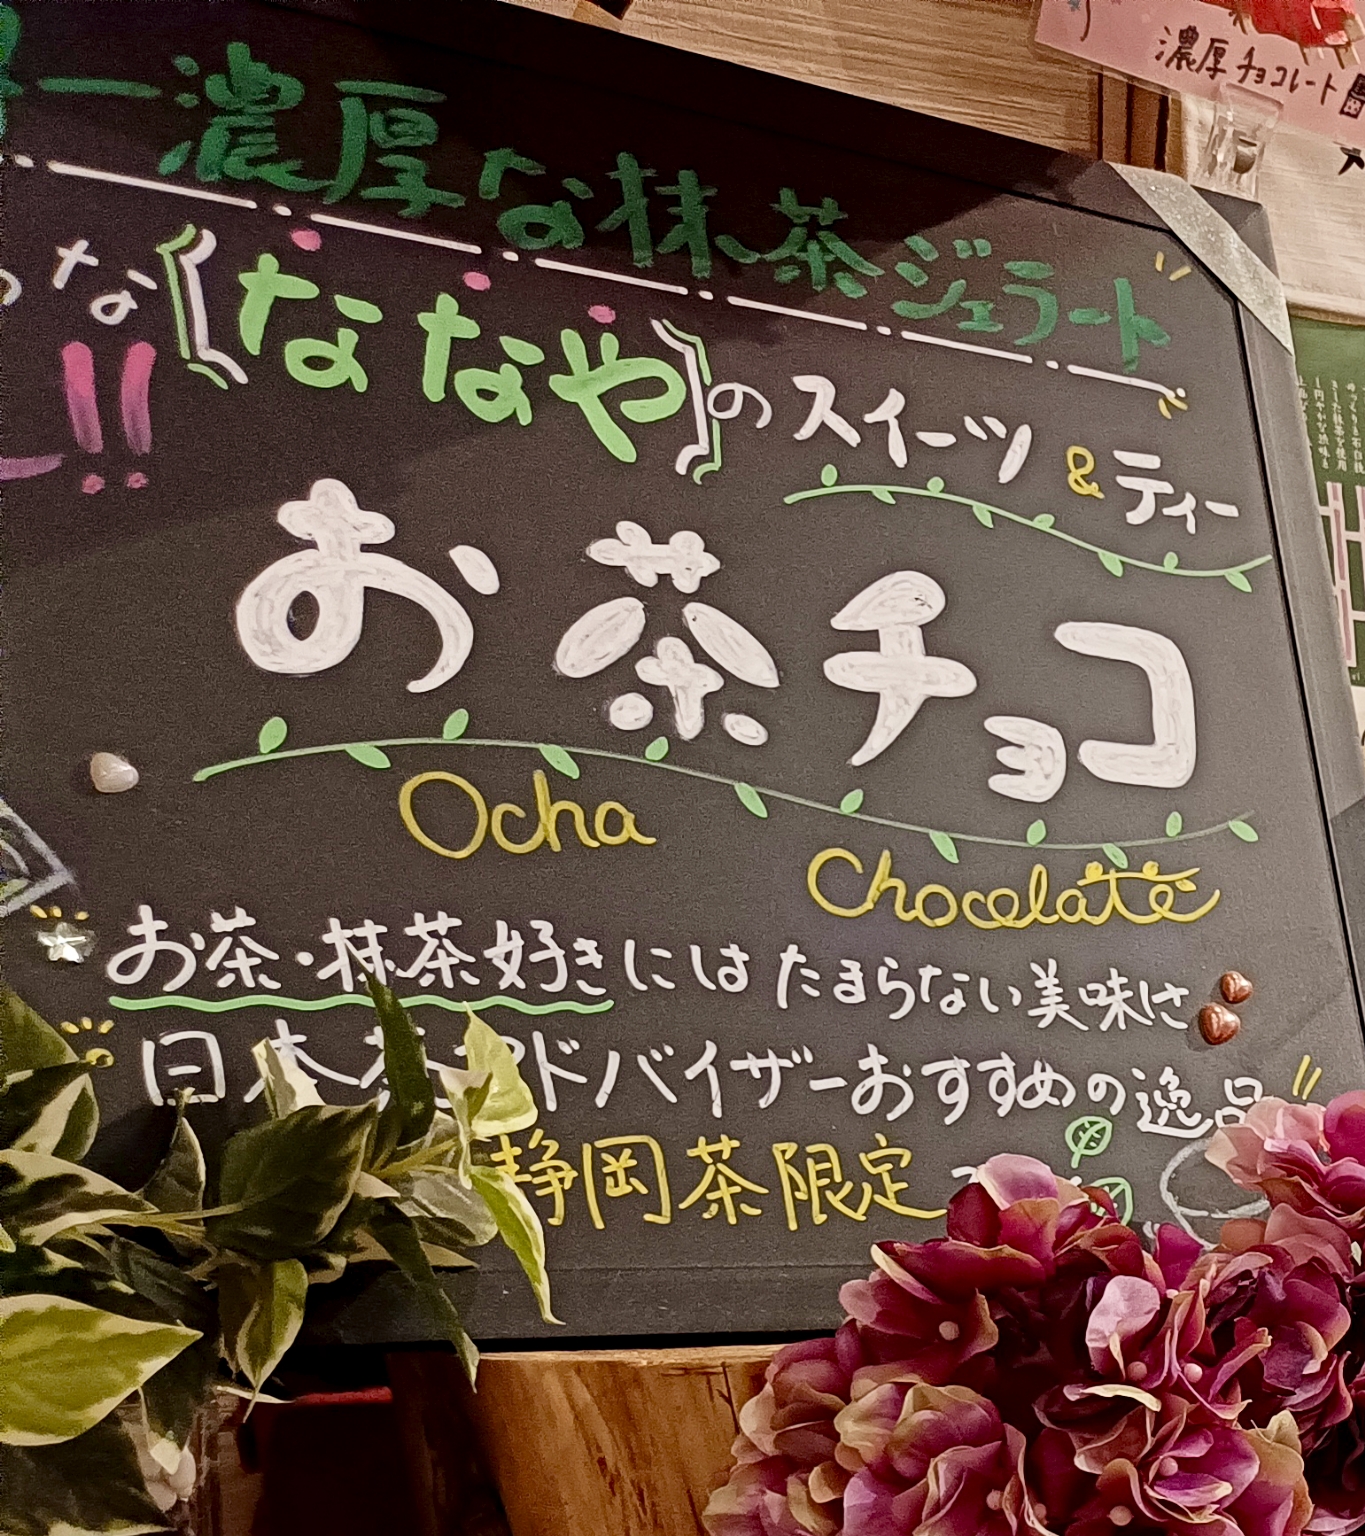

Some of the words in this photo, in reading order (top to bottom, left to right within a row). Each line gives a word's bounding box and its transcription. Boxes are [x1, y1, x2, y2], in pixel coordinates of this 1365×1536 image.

[1154, 26, 1338, 104] 濃厚チョコレート
[1112, 450, 1238, 533] ティー
[236, 478, 1196, 802] お茶チョコ
[400, 770, 656, 858] Ocha
[807, 848, 1220, 928] Chocolate
[490, 1128, 948, 1232] 静岡茶限定
